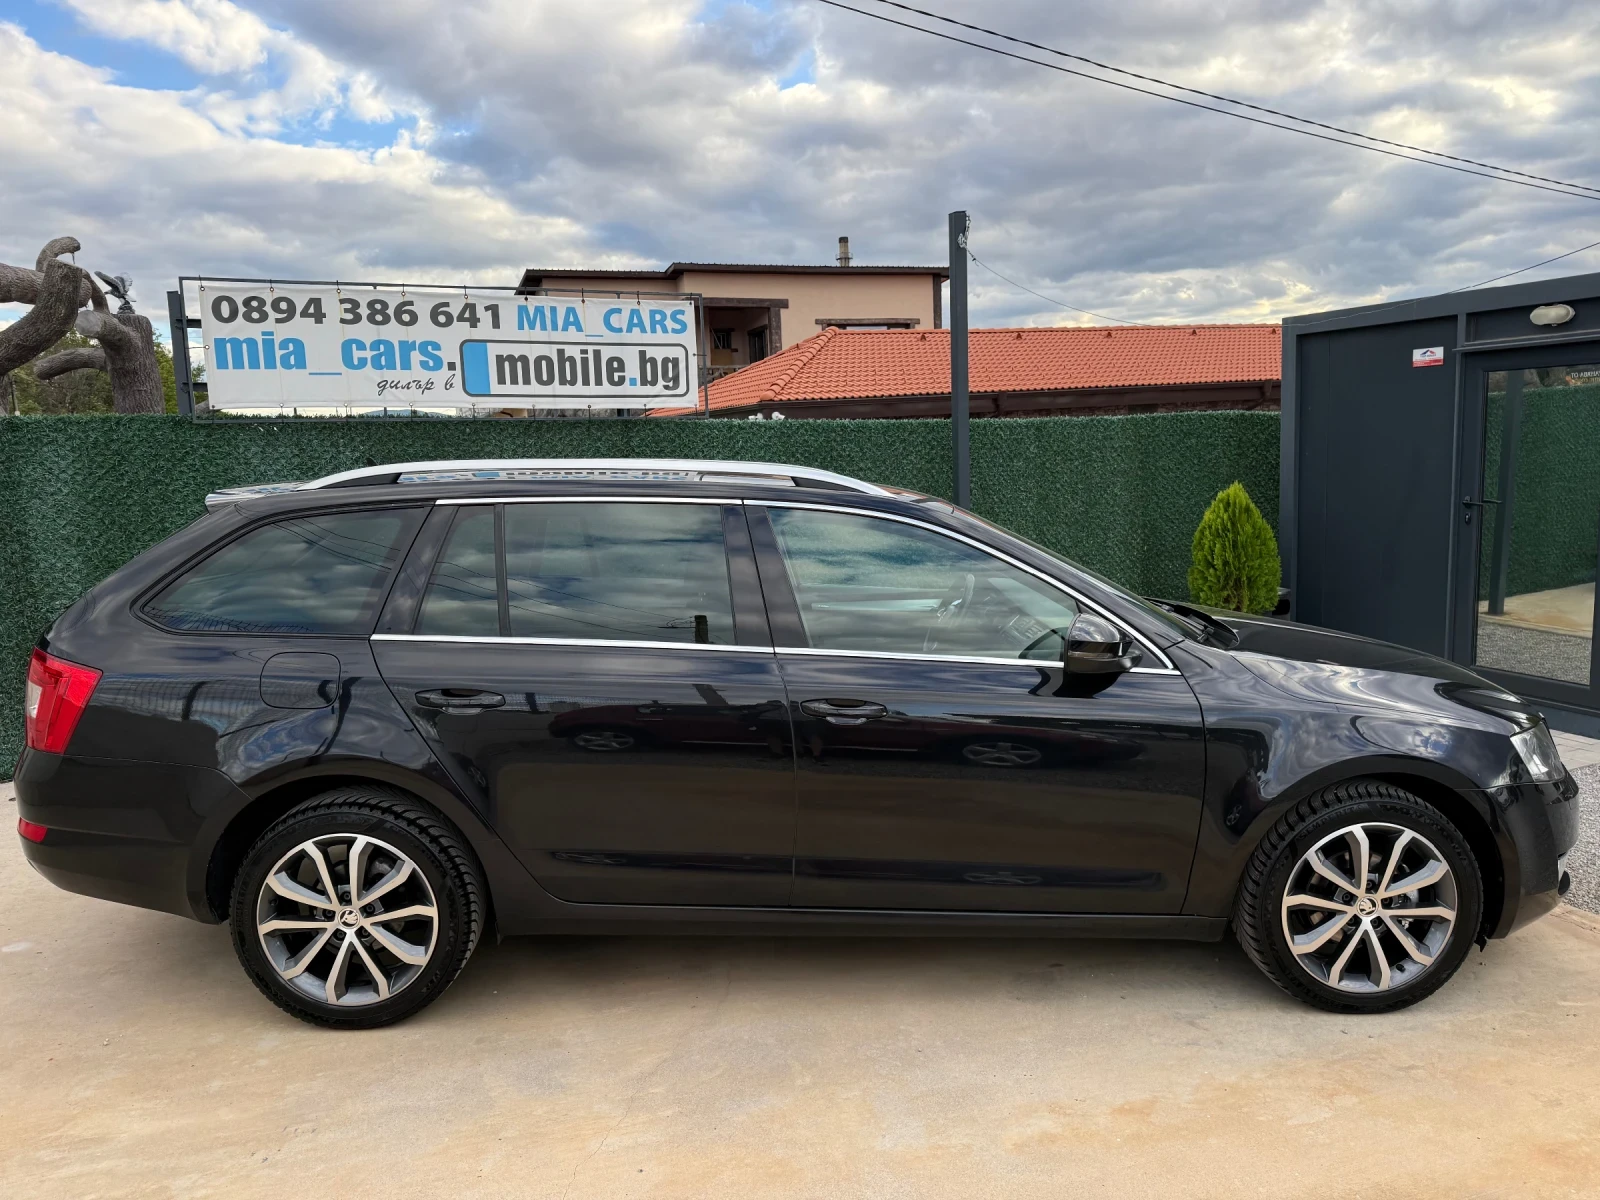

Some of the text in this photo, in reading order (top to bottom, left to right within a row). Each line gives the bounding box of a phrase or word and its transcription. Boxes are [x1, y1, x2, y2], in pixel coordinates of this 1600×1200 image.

[211, 295, 688, 338] 0894 386 641 MIA_CARS
[376, 373, 457, 397] дилър в
[495, 348, 681, 391] mobile.bg
